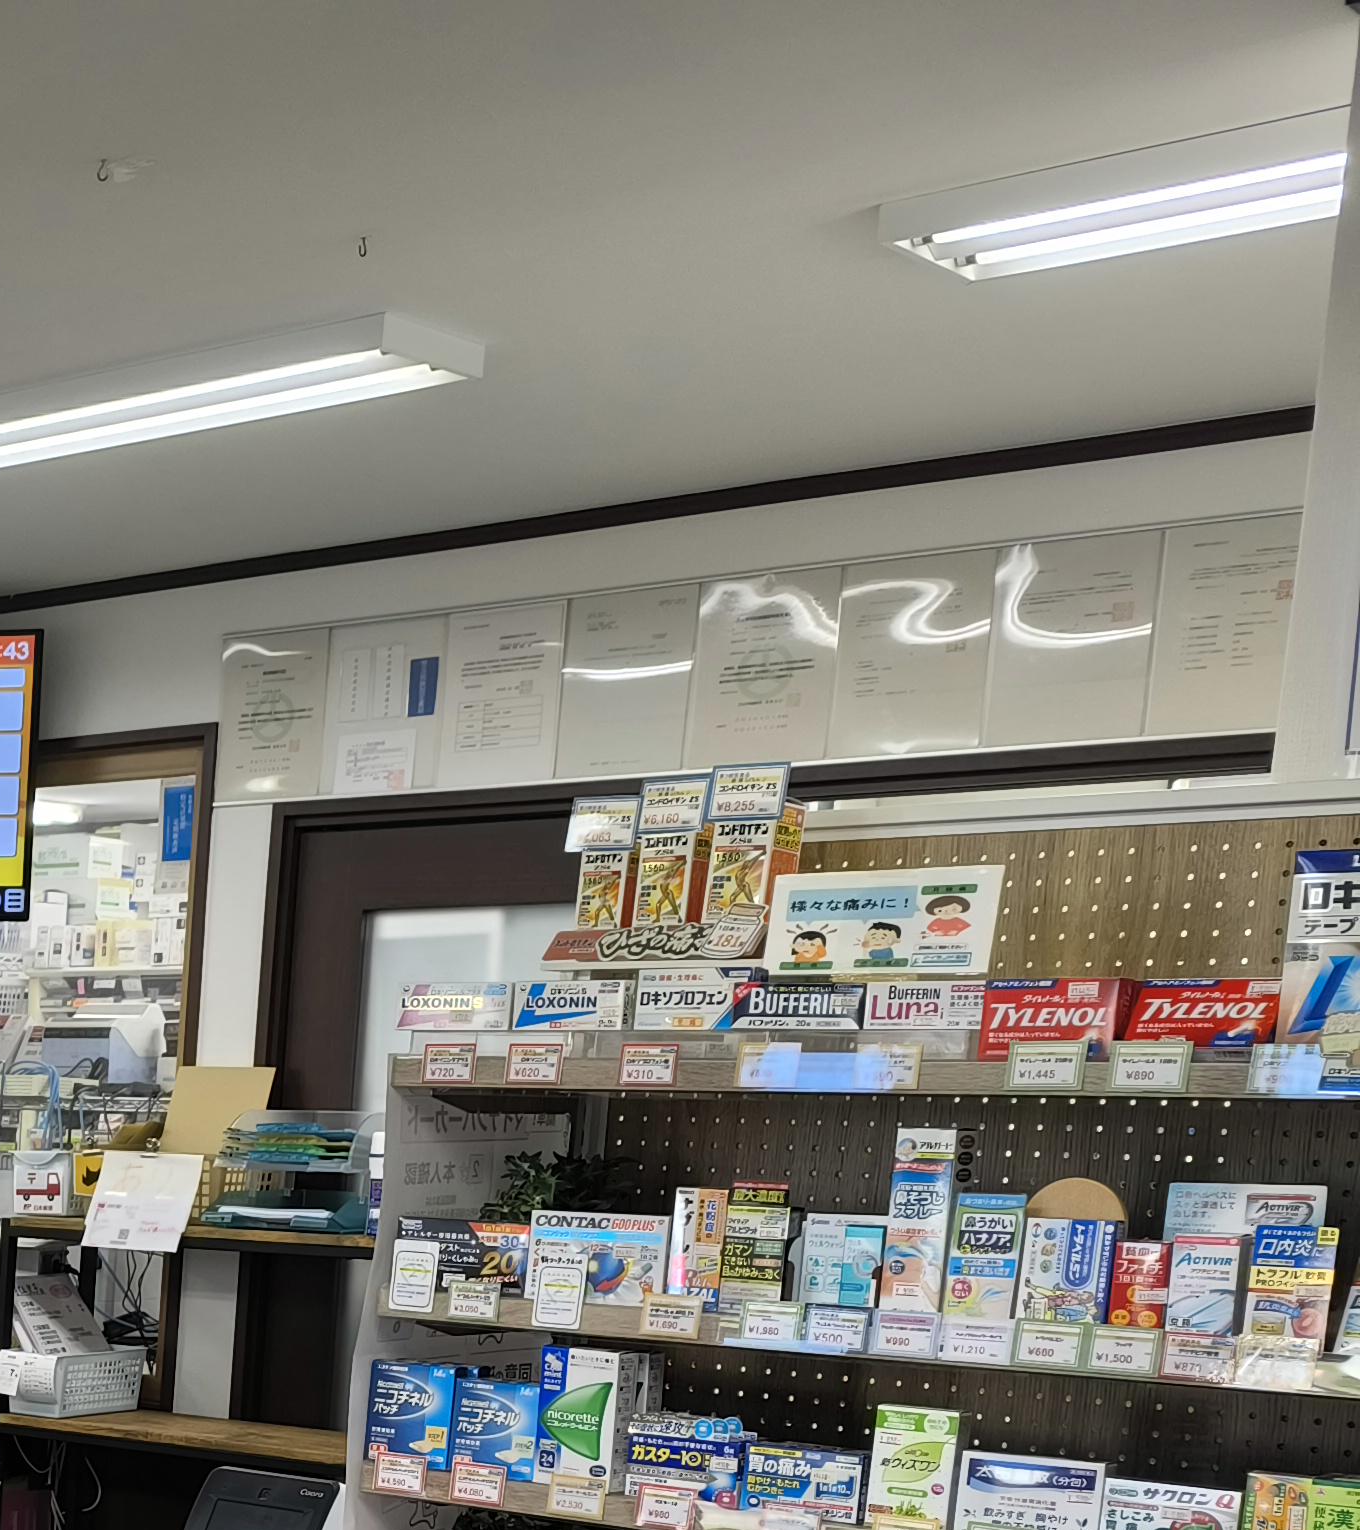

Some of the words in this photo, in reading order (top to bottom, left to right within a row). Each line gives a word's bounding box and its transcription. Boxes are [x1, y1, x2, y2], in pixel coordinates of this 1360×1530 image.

[715, 799, 756, 813] ¥8,255
[643, 812, 680, 825] ¥6,160
[718, 822, 770, 837] コンドロイチン
[643, 834, 689, 849] コンドロイチン
[584, 852, 624, 865] コンドロイチン
[789, 897, 912, 914] 様々な痛みに！
[1303, 917, 1360, 935] テープ
[638, 990, 729, 1008] ロキソプロフェン
[887, 985, 942, 1002] BUFFERIN
[525, 995, 598, 1009] LOXONIN
[988, 1005, 1108, 1028] TYLENOL
[1138, 998, 1268, 1022] TYLENOL
[747, 1018, 788, 1029] バファリン
[429, 1067, 455, 1078] ¥720
[514, 1067, 540, 1078] ¥620
[626, 1068, 654, 1080] ¥310
[1018, 1069, 1056, 1081] ¥1,445
[1125, 1069, 1155, 1081] ¥890
[918, 1138, 954, 1151] アルガード
[893, 1205, 945, 1220] スプレー
[1255, 1201, 1302, 1214] ACTIVIR
[535, 1213, 611, 1230] CONTAC
[963, 1214, 1015, 1233] 鼻うがい
[723, 1244, 753, 1256] ガマン
[1175, 1251, 1233, 1268] ACTIVIR
[648, 1319, 679, 1331] ¥1,690
[747, 1325, 780, 1337] ¥1,980
[813, 1332, 843, 1344] ¥500
[952, 1344, 986, 1355] ¥1,210
[1095, 1351, 1133, 1364] ¥1,500
[374, 1389, 434, 1408] ニコチネル
[373, 1403, 400, 1415] パッチ
[458, 1406, 521, 1427] ニコチネル
[547, 1409, 600, 1424] nicorette
[456, 1421, 485, 1434] パッチ
[746, 1456, 812, 1479] 胃の痛み
[555, 1499, 584, 1511] ¥2,530
[982, 1506, 1027, 1522] 飲みすぎ
[1035, 1511, 1068, 1526] 胸やけ
[1105, 1508, 1156, 1523] さしこみ
